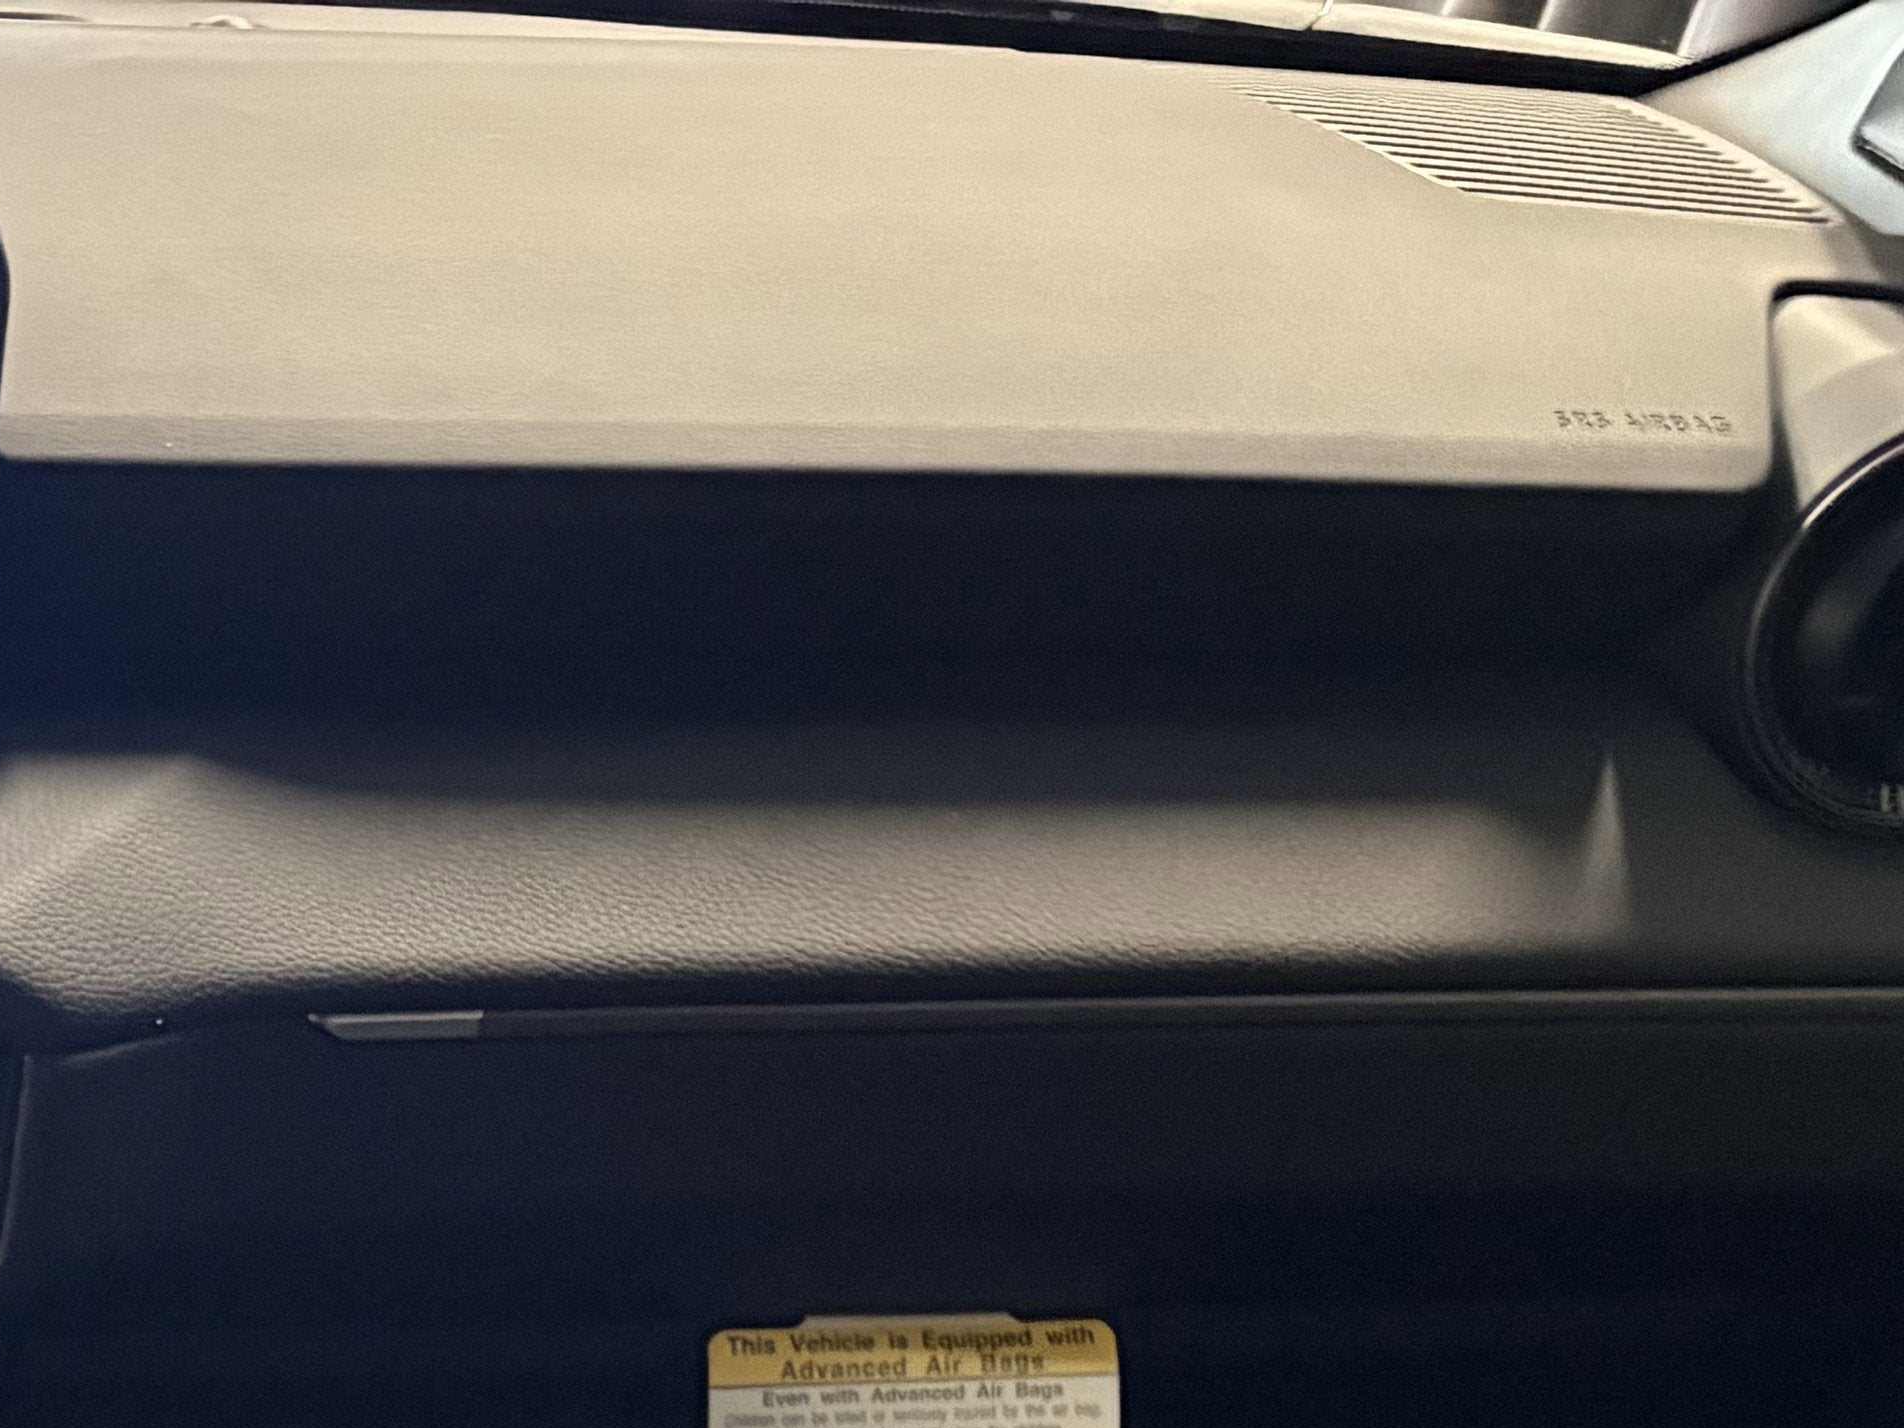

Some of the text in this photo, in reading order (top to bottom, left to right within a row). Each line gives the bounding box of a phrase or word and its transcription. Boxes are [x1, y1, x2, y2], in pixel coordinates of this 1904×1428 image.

[728, 1335, 776, 1356] This
[789, 1332, 875, 1352] Vehicle
[921, 1327, 1033, 1353] Equipped
[1045, 1326, 1095, 1346] with
[782, 1352, 1045, 1380] Advanced Air Bags
[763, 1382, 1064, 1408] Even with Advanced Air Bags
